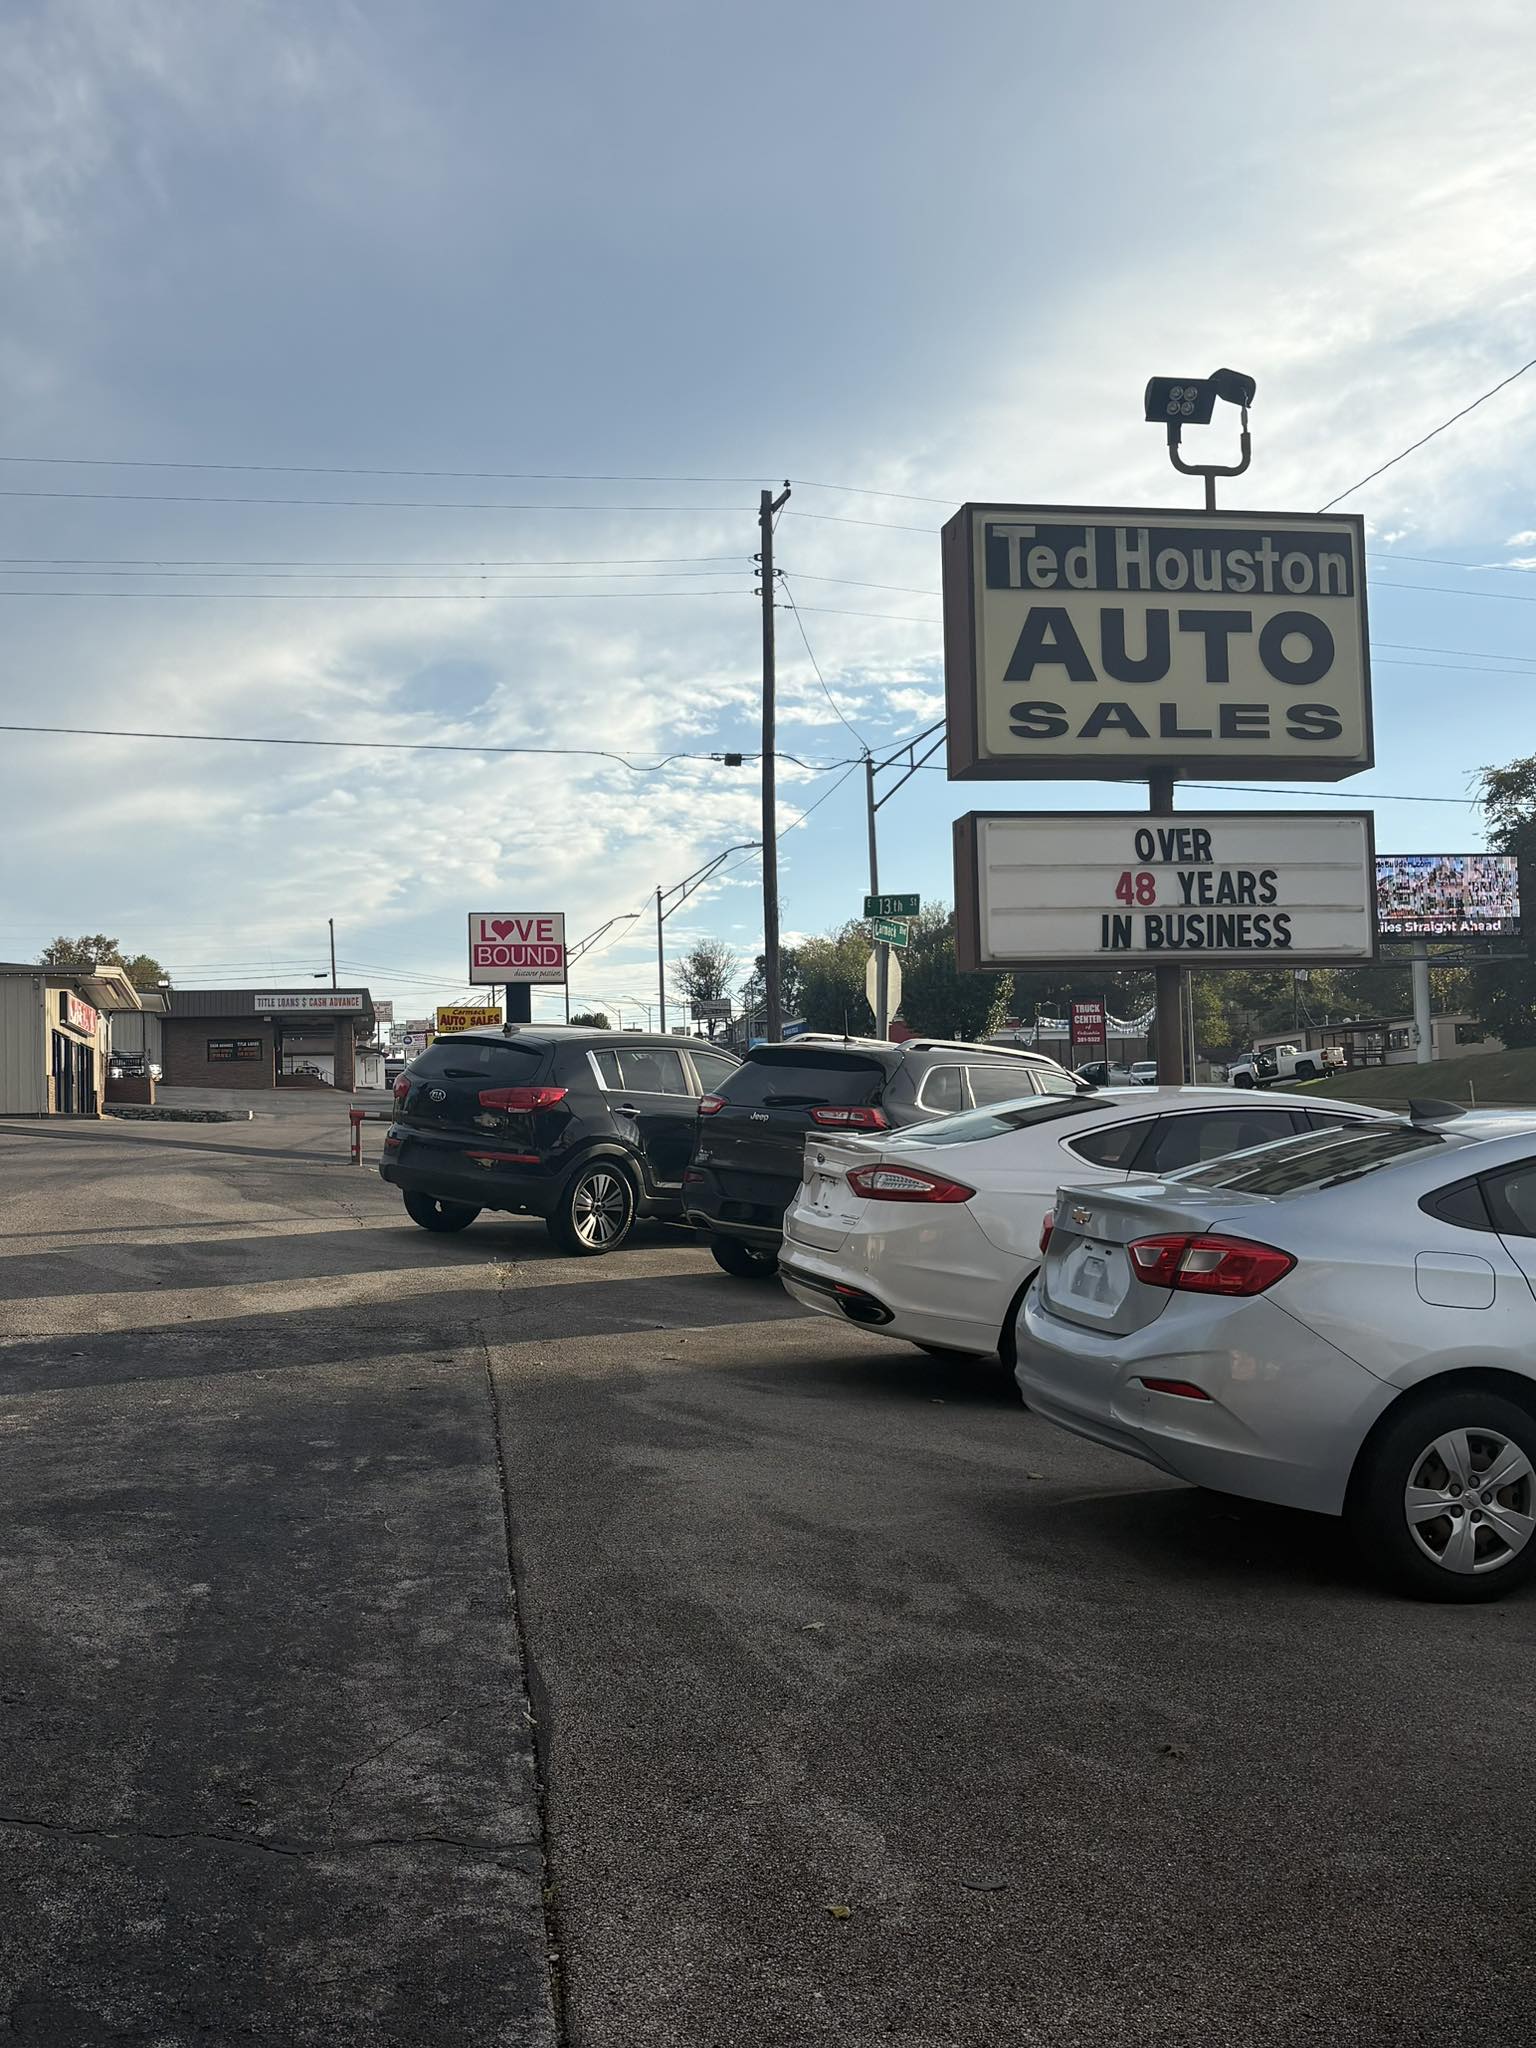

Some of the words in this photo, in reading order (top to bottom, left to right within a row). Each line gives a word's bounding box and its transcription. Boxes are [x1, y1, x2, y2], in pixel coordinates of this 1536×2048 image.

[992, 525, 1097, 589] Ted
[1115, 527, 1348, 596] Houston
[1003, 606, 1335, 686] AUTO
[1008, 701, 1343, 741] SALES
[1134, 828, 1213, 862] OVER
[1115, 871, 1156, 906] 48
[1177, 869, 1278, 905] YEARS
[867, 898, 872, 908] E
[879, 898, 903, 915] 13th
[1101, 914, 1132, 948] IN
[1144, 913, 1292, 949] BUSINESS
[1378, 921, 1402, 933] iles
[1405, 920, 1457, 933] Straight
[1460, 920, 1501, 931] Ahead
[478, 946, 559, 965] BOUND
[258, 998, 275, 1007] TITLE
[278, 998, 299, 1007] LOANS
[309, 998, 327, 1007] CASH
[329, 997, 360, 1007] ADVANCE
[1075, 1004, 1101, 1013] TRUCK
[440, 1014, 466, 1026] AUTO
[470, 1013, 500, 1026] SALES
[1074, 1015, 1102, 1024] CENTER
[750, 1112, 769, 1122] Jeep
